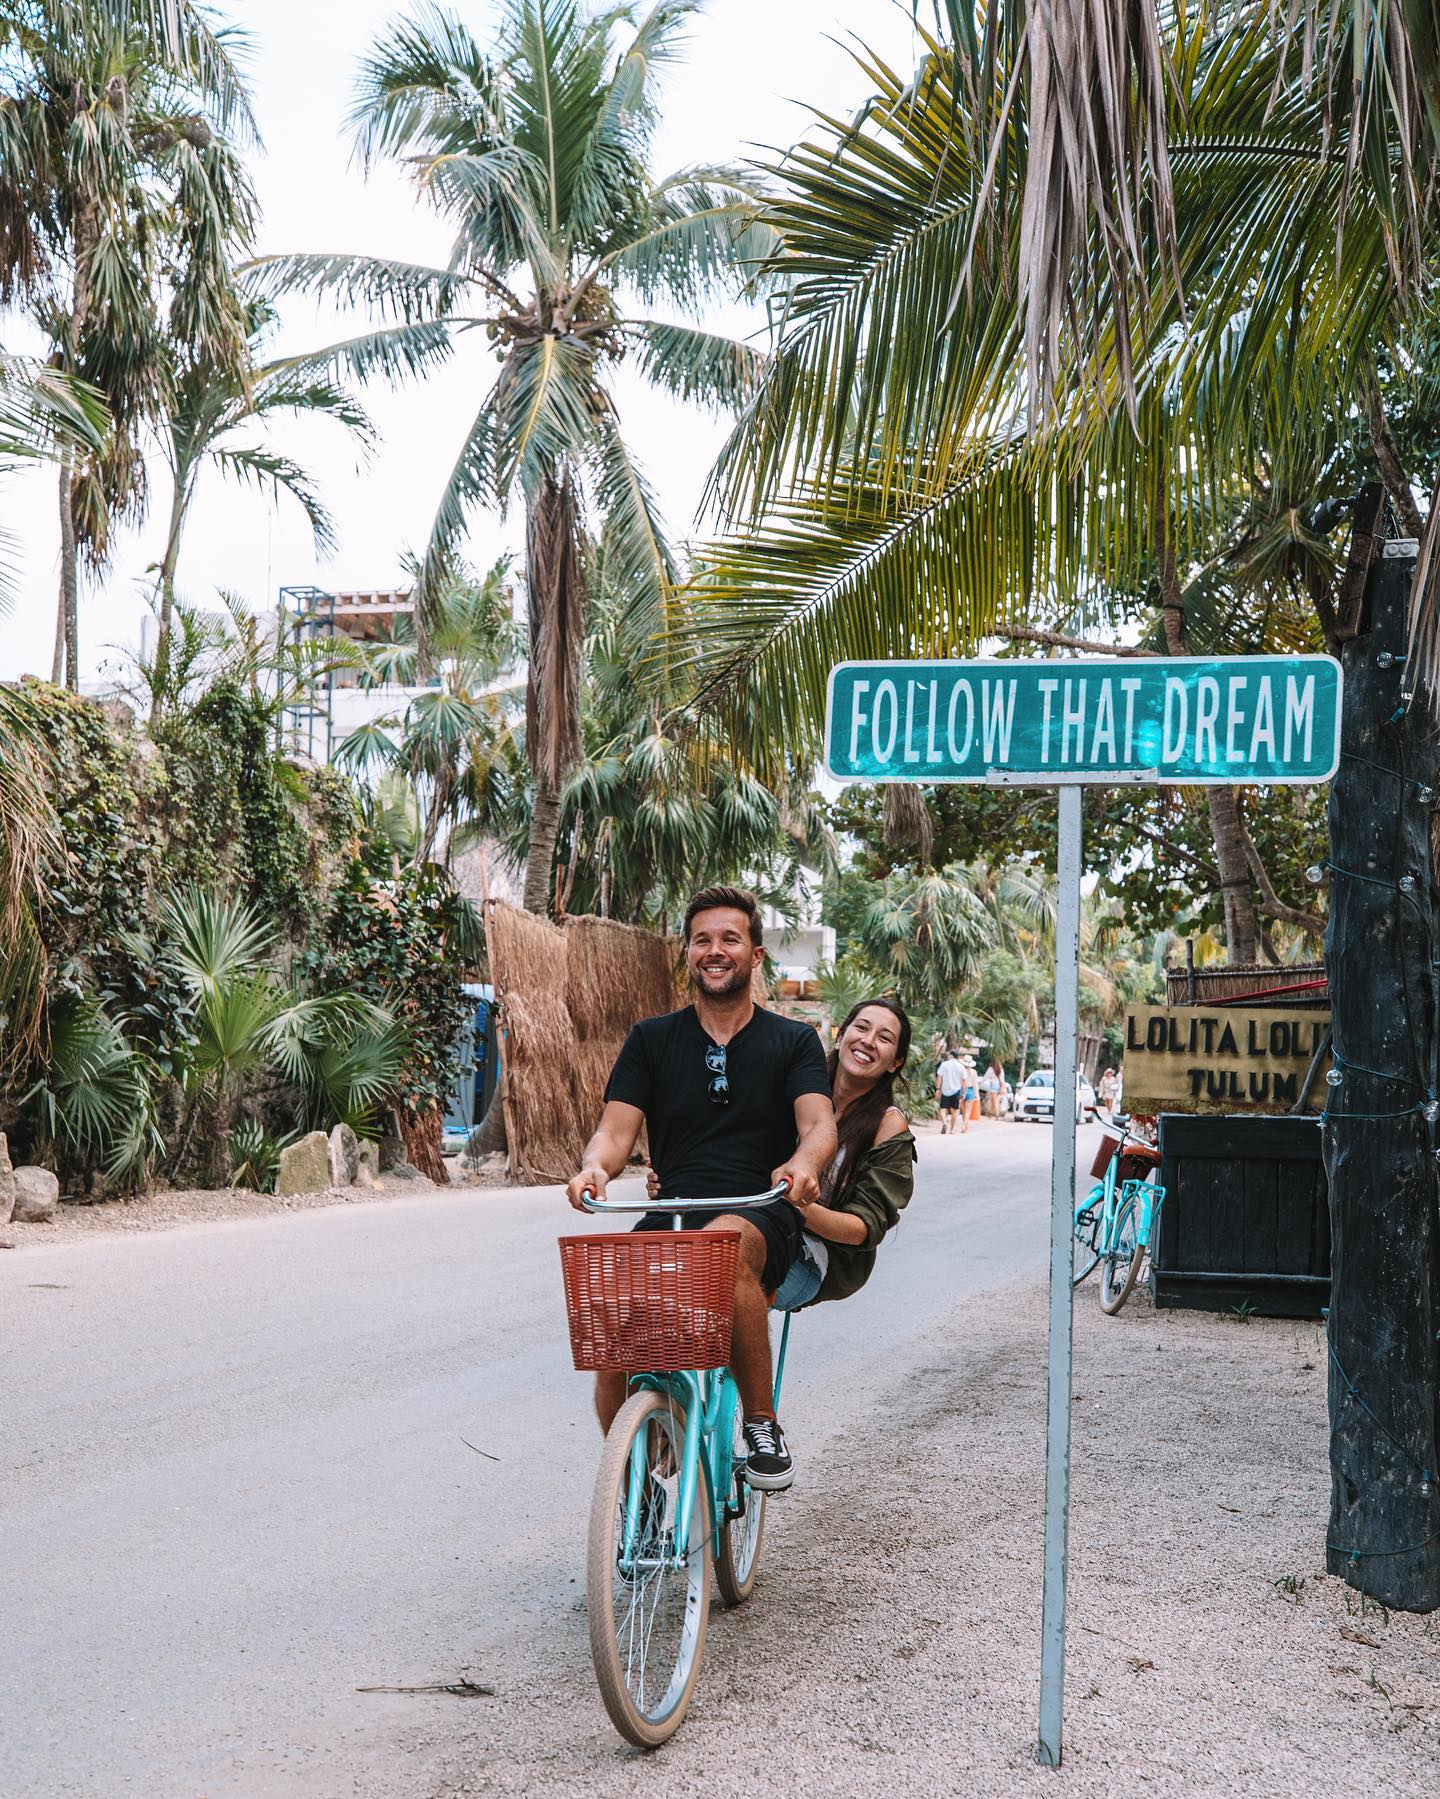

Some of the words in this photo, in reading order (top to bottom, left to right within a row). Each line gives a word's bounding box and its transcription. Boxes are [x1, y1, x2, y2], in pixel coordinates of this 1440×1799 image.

[849, 678, 1016, 765] FOLLOW
[1038, 678, 1142, 764] THAT
[1162, 675, 1316, 764] DREAM
[1126, 1016, 1239, 1054] LOLITA
[1187, 1069, 1299, 1100] TULUM
